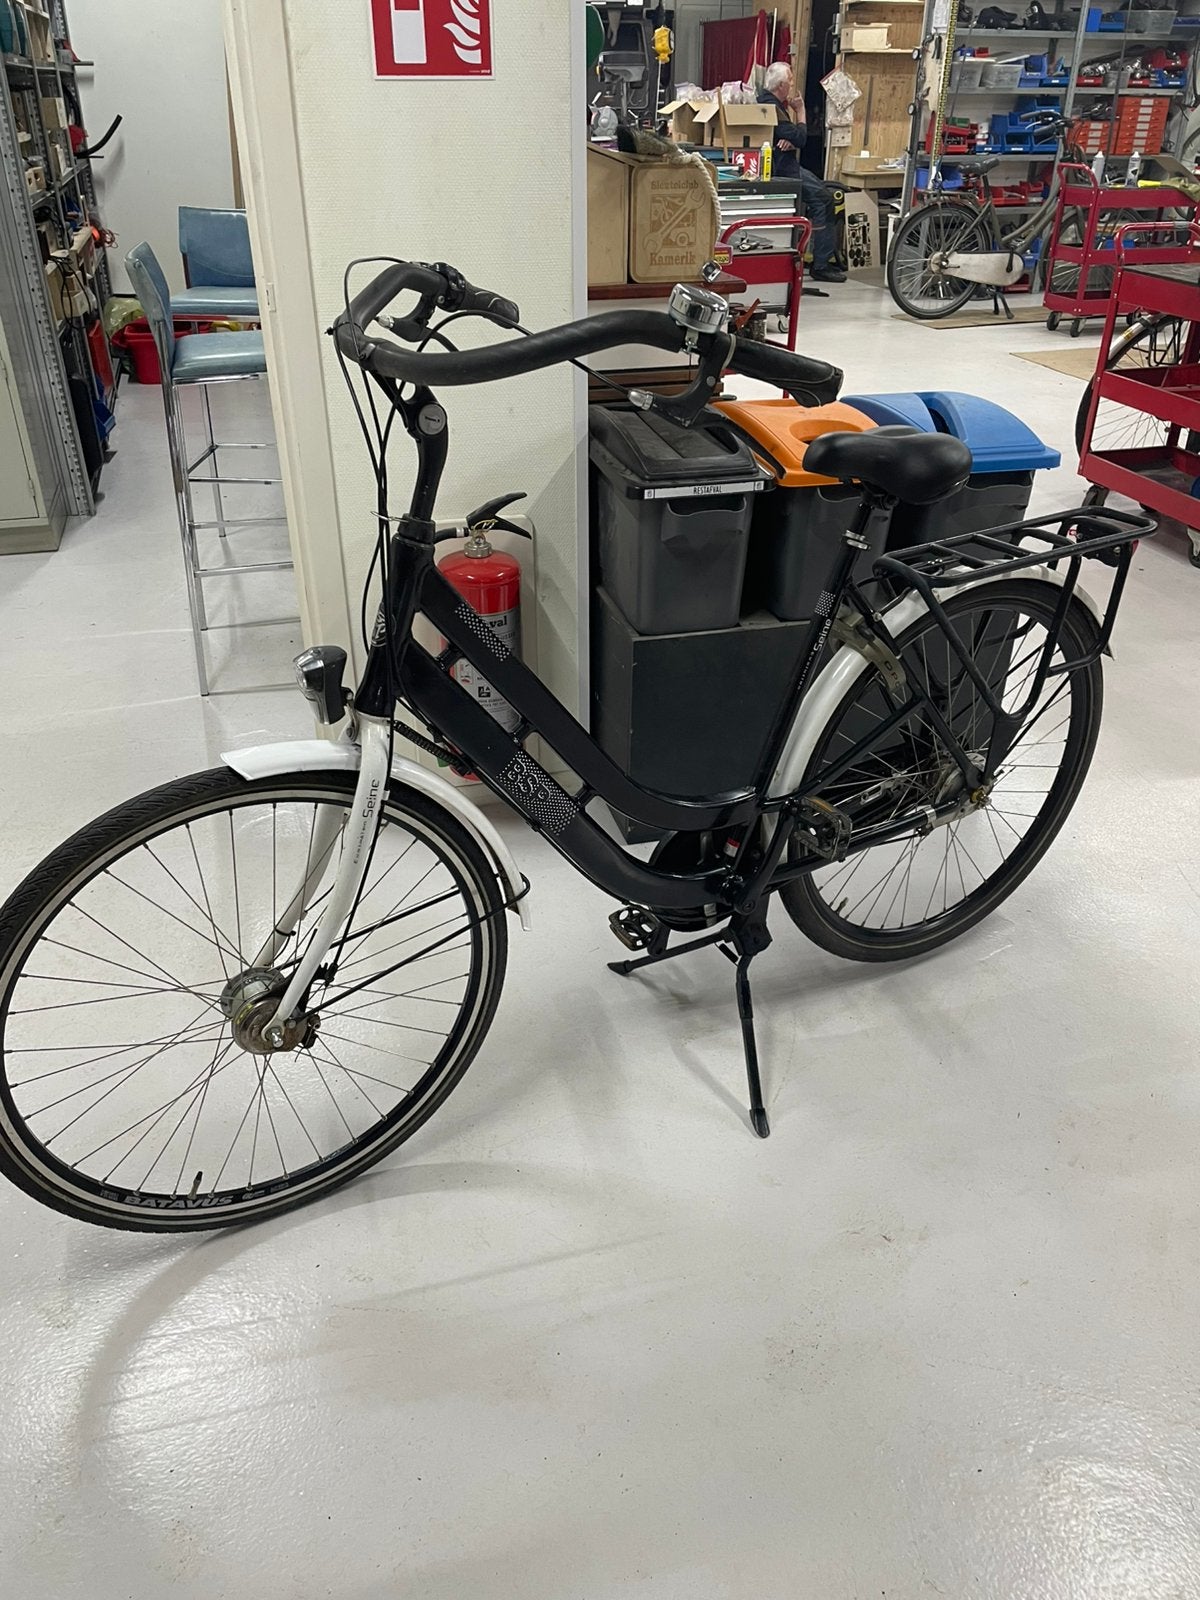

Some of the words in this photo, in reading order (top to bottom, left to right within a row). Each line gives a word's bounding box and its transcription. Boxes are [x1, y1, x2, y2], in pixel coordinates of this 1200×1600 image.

[649, 251, 697, 266] Kamerik
[693, 484, 722, 495] RESTAFVAL
[362, 779, 380, 818] Seine
[123, 1195, 233, 1210] BATAVUS
